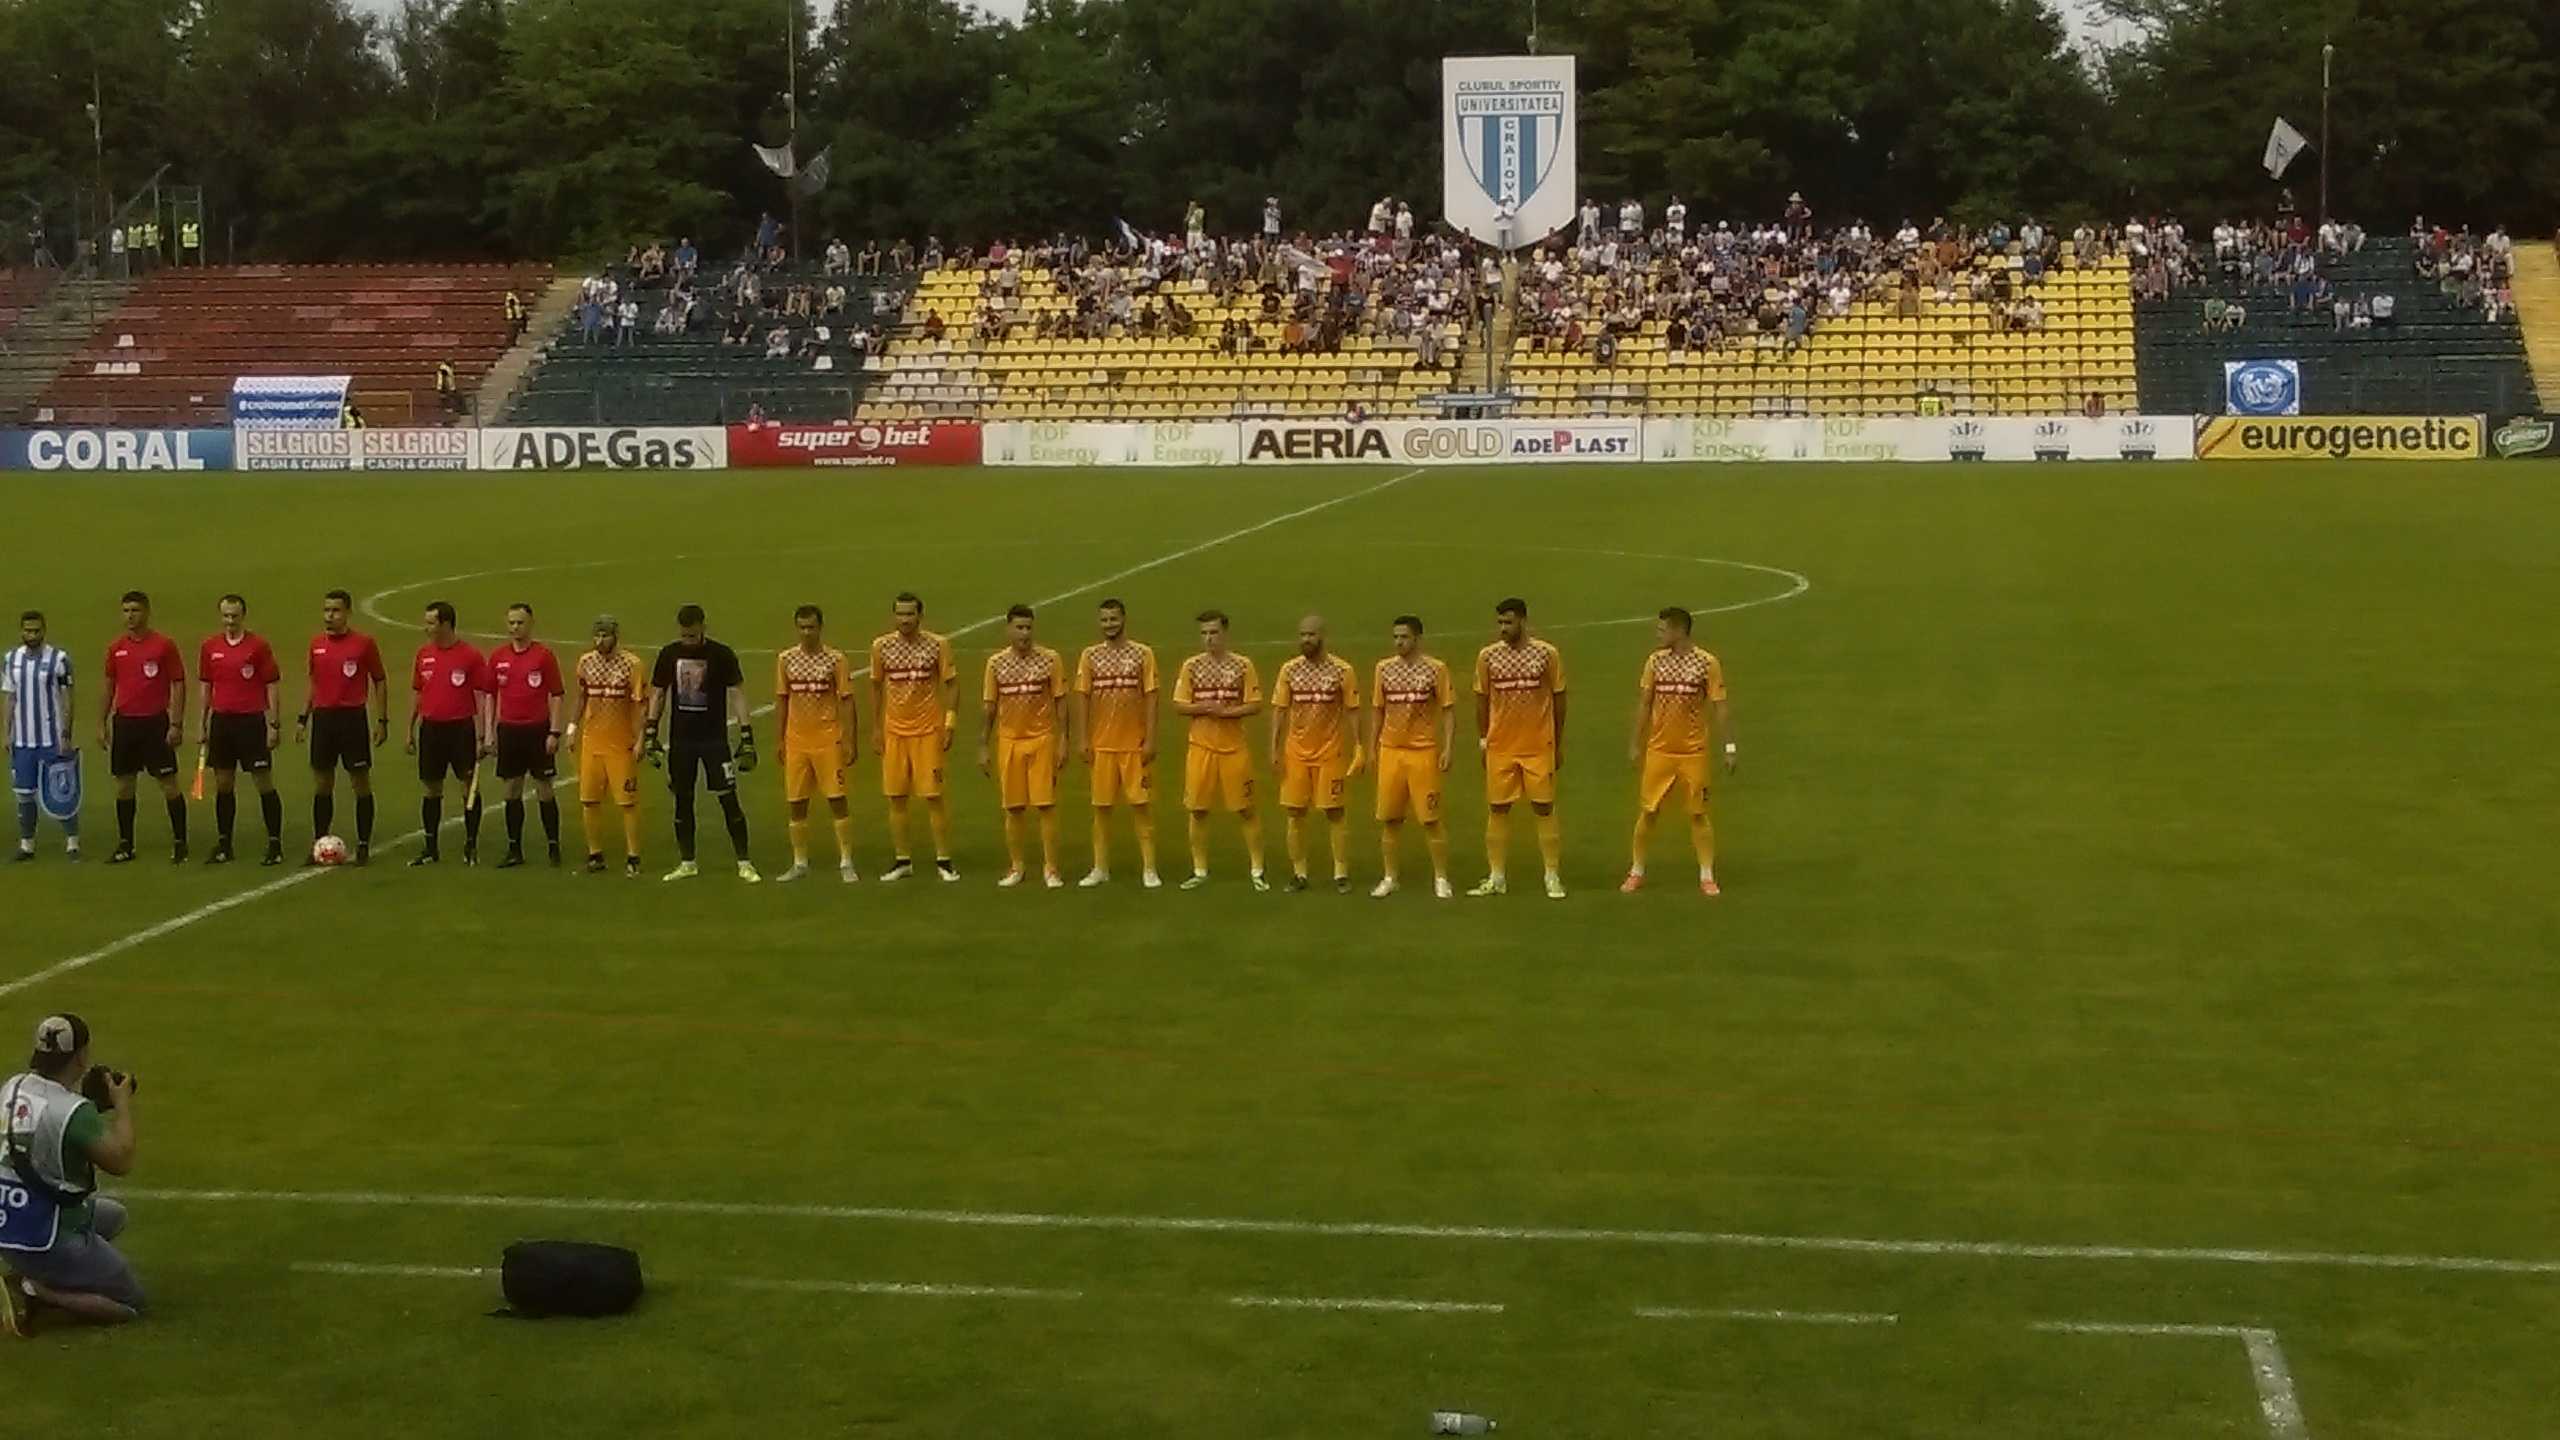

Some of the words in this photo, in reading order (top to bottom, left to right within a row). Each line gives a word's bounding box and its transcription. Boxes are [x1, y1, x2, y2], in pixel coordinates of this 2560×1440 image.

[1458, 81, 1505, 91] CLUBUL
[1508, 80, 1561, 91] SPORTIV
[1461, 98, 1558, 112] UNIVERSITATEA
[1503, 120, 1516, 203] CRAIOVA
[1030, 425, 1071, 441] KDF
[1154, 425, 1196, 441] KDF
[1693, 419, 1735, 437] KDF
[1823, 419, 1866, 437] KDF
[2240, 417, 2471, 457] eurogenetic
[27, 430, 205, 470] CORAL
[248, 431, 350, 455] SELGROS
[364, 431, 467, 455] SELGROS
[512, 429, 695, 468] ADEGas
[1247, 428, 1392, 459] AERIA
[1403, 427, 1504, 459] GOLD
[1512, 430, 1629, 454] ADEPLAST
[1693, 441, 1767, 460] Energy
[1823, 441, 1898, 459] Energy
[1030, 444, 1101, 464] Energy
[1154, 444, 1224, 464] Energy
[251, 458, 288, 470] CASH
[290, 458, 299, 470] &
[301, 458, 345, 470] CARRY
[368, 458, 402, 470] CASH
[405, 458, 416, 470] &
[418, 458, 464, 470] CARRY
